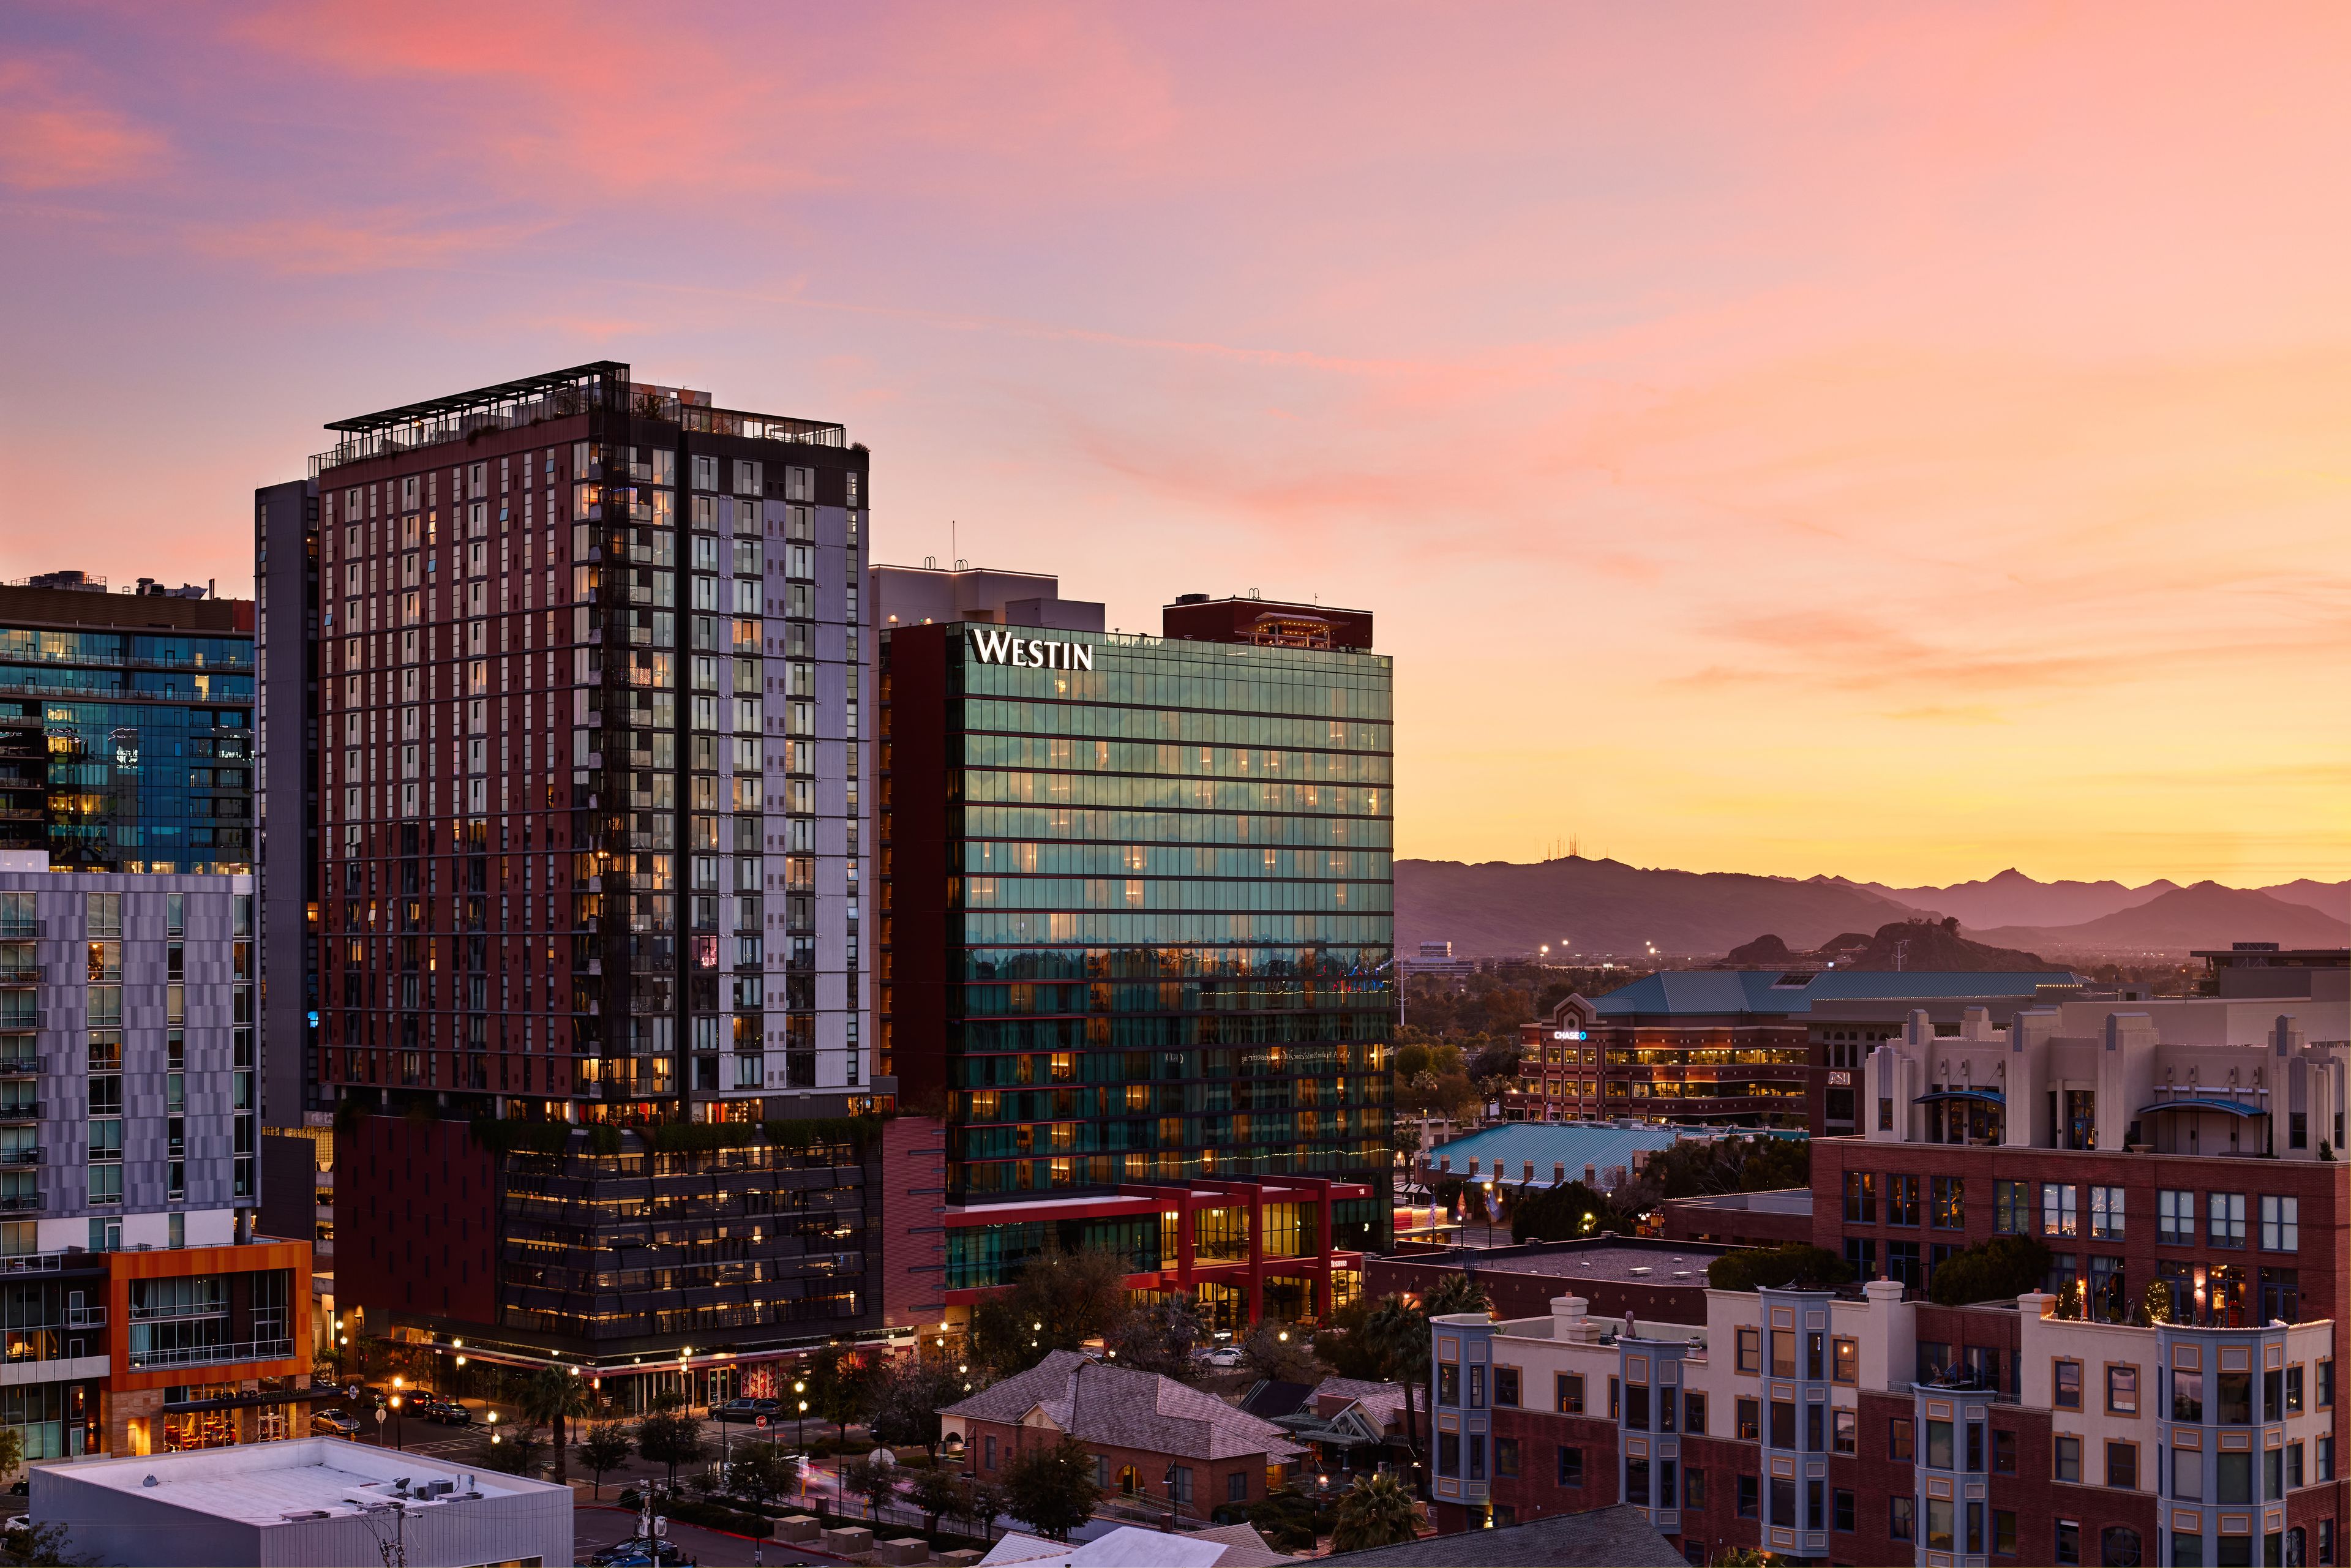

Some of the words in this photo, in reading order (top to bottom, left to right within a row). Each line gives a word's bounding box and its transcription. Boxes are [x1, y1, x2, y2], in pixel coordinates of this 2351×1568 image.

[973, 629, 1093, 671] WESTIN
[1554, 1031, 1580, 1040] CHASE
[1828, 1071, 1850, 1085] ASU
